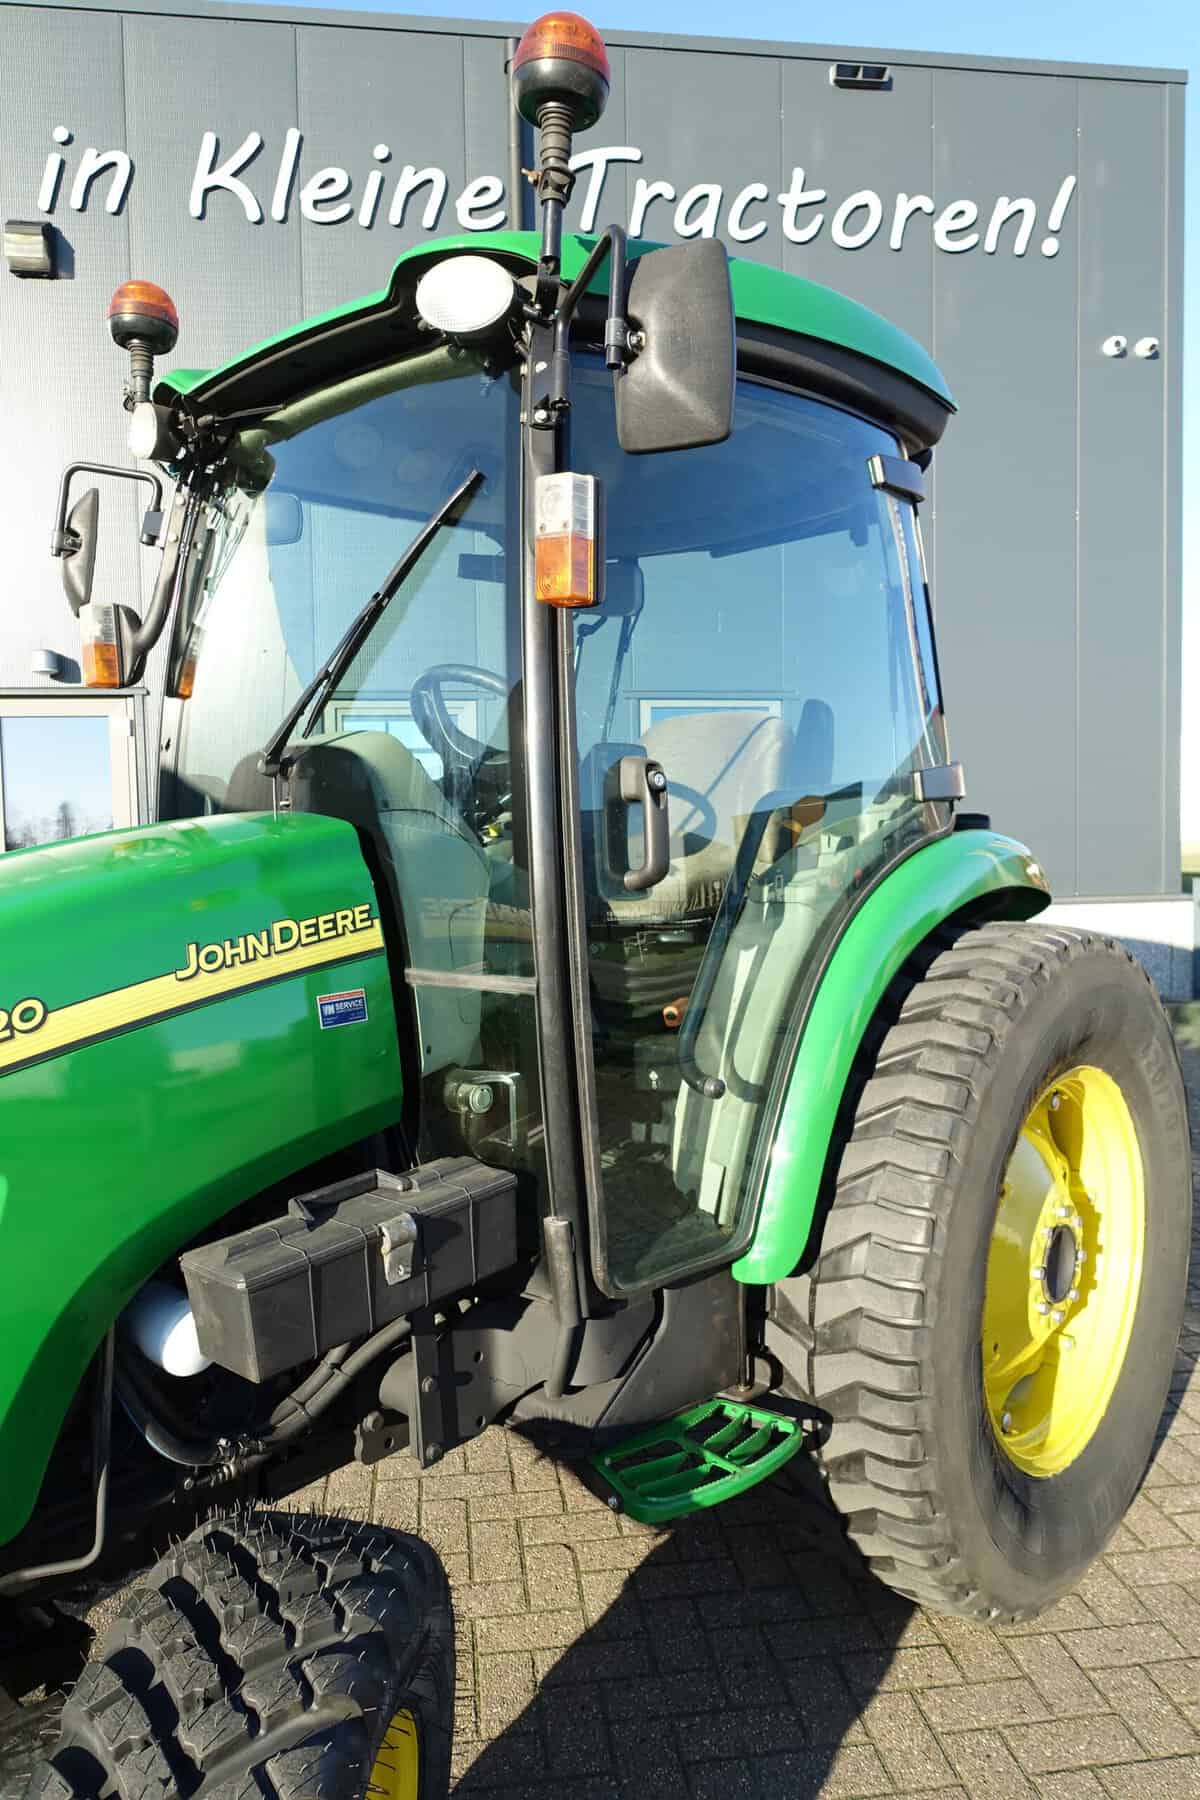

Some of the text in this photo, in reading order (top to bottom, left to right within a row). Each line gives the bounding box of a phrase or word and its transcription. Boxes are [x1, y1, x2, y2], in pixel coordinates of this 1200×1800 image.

[37, 126, 1076, 257] in Kleine Tractoren!
[175, 929, 269, 981] JOHN
[271, 903, 373, 954] DEERE
[335, 999, 365, 1011] SERVICE
